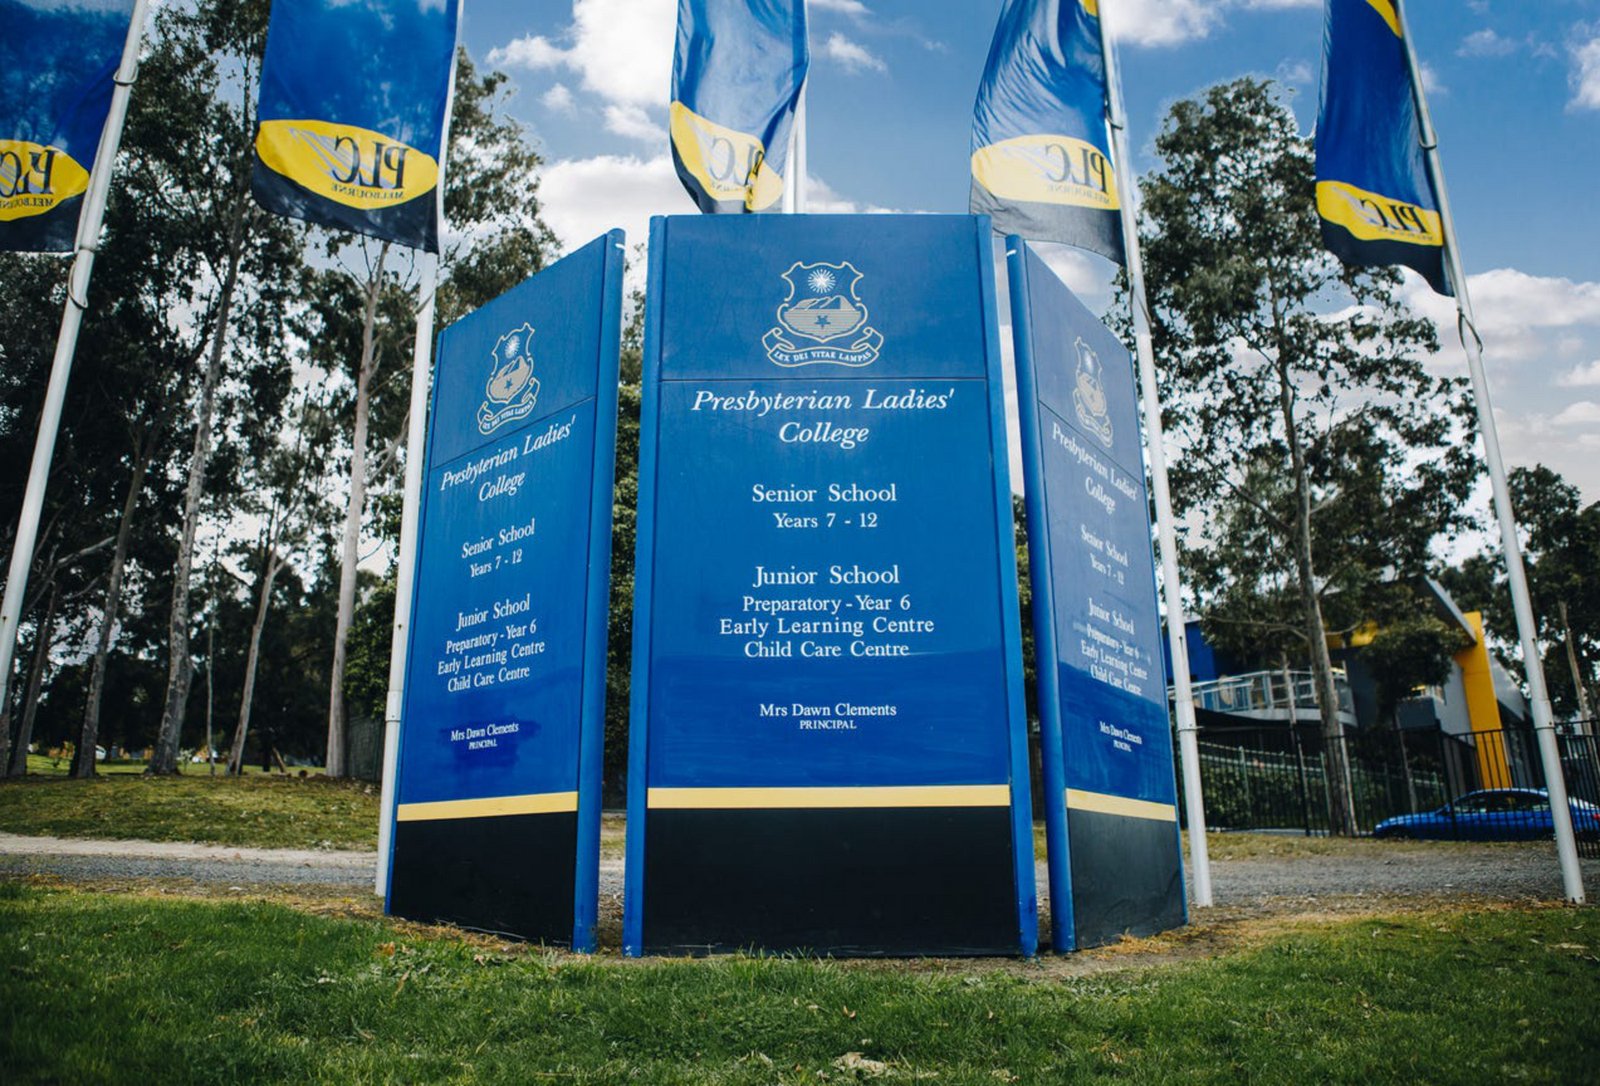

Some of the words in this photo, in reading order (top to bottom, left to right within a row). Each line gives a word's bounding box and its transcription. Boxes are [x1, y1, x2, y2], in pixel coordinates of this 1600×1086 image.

[774, 350, 790, 362] LEX
[793, 352, 809, 362] DEI
[811, 350, 836, 359] VITAE
[839, 350, 872, 363] LAMPAS
[691, 389, 852, 417] Presbyterian
[862, 387, 955, 410] Ladies'
[779, 421, 869, 450] College
[440, 448, 518, 491] Presbyterian
[522, 414, 576, 456] Ladies'
[478, 472, 525, 502] College
[752, 484, 817, 502] Senior
[828, 483, 897, 502] School
[1085, 475, 1116, 515] College
[773, 513, 818, 529] Years
[826, 513, 836, 528] 7
[859, 513, 878, 528] 12
[461, 536, 494, 559] Senior
[498, 518, 535, 546] School
[469, 561, 492, 578] Years
[495, 555, 502, 570] 7
[512, 549, 523, 564] 12
[753, 566, 818, 588] Junior
[829, 565, 900, 585] School
[456, 607, 488, 632] Junior
[493, 593, 530, 620] School
[742, 595, 842, 615] Preparatory
[855, 594, 892, 611] Year
[900, 594, 911, 611] 6
[446, 630, 498, 655] Preparatory
[506, 623, 527, 640] Year
[529, 618, 537, 634] 6
[720, 618, 769, 639] Early
[777, 617, 864, 637] Learning
[872, 616, 934, 633] Centre
[438, 657, 461, 676] Early
[464, 647, 508, 670] Learning
[511, 641, 545, 659] Centre
[744, 641, 792, 658] Child
[800, 641, 841, 657] Care
[850, 640, 910, 657] Centre
[448, 674, 470, 692] Child
[473, 671, 495, 688] Care
[498, 665, 530, 682] Centre
[759, 703, 788, 717] Mrs
[792, 703, 831, 717] Dawn
[835, 703, 897, 716] Clements
[451, 730, 465, 742] Mrs
[487, 722, 519, 736] Clements
[799, 720, 857, 730] PRINCIPAL
